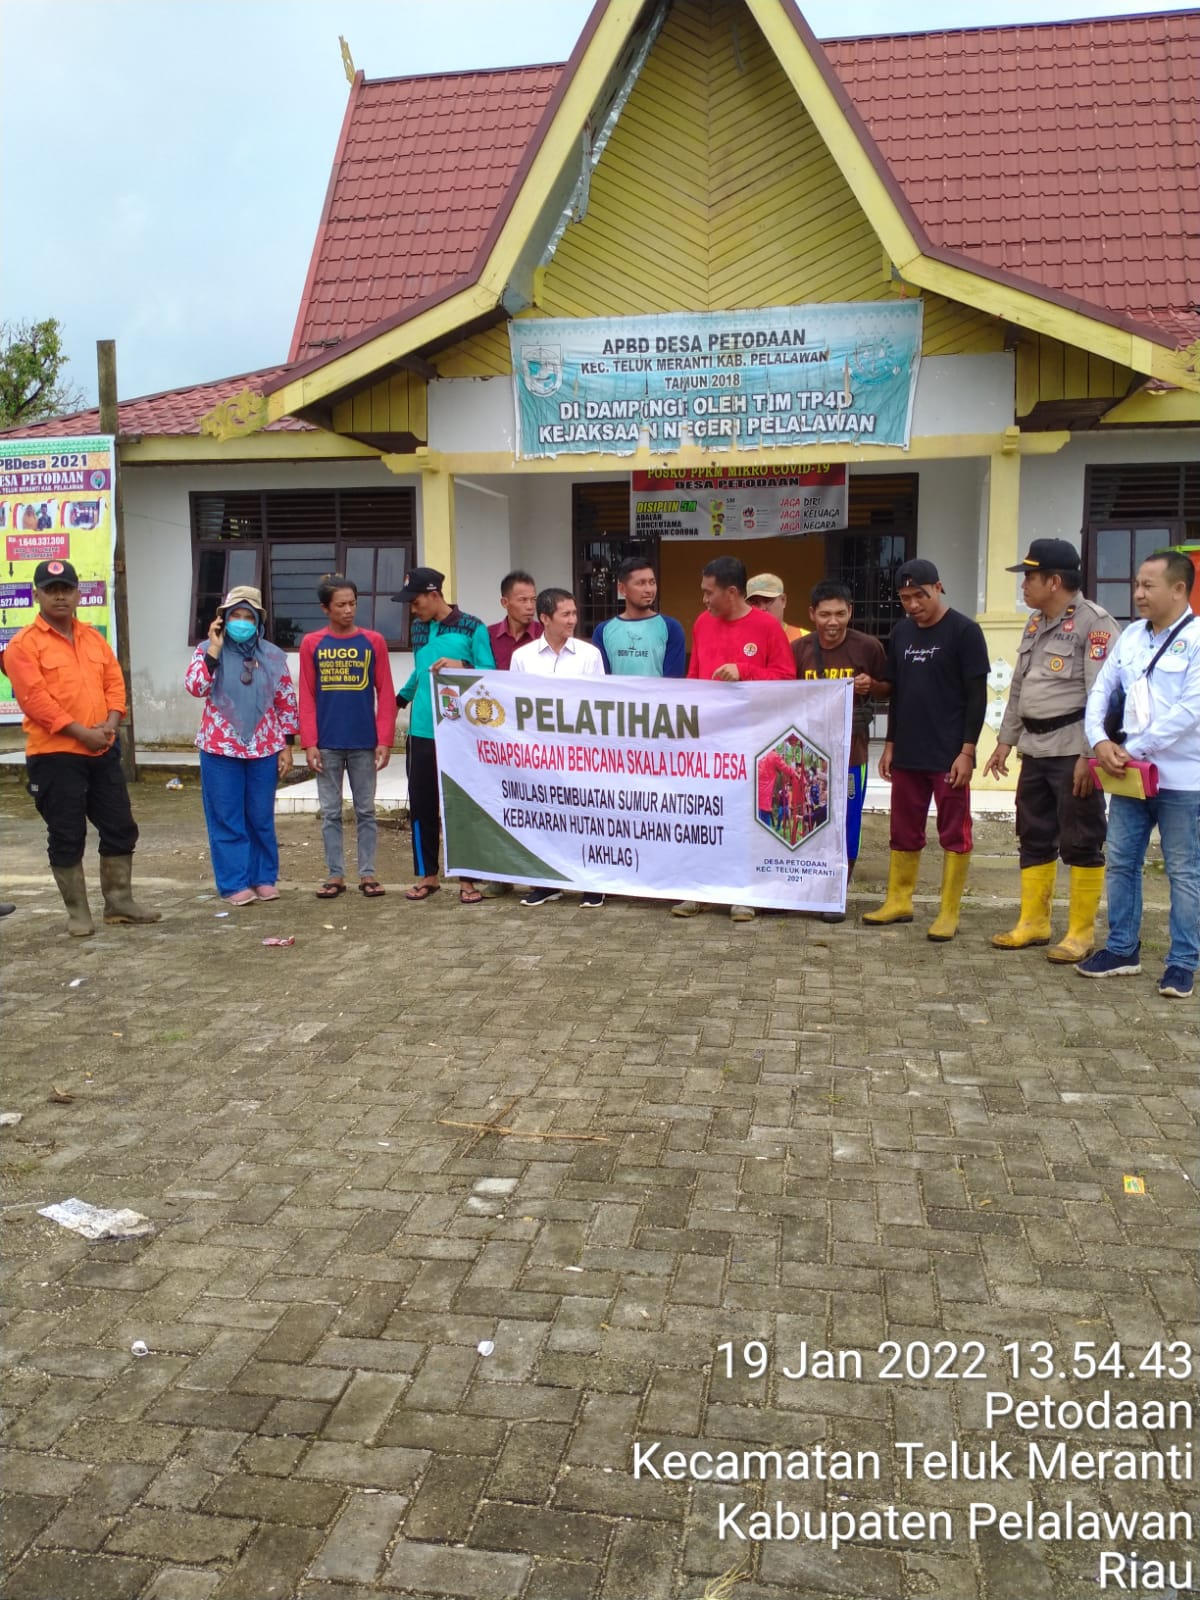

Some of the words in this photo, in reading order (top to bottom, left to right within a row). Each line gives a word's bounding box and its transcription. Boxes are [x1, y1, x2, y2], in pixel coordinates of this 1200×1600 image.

[602, 336, 650, 355] APBD
[655, 334, 703, 353] DESA
[708, 328, 806, 351] PETODAAN
[581, 360, 610, 374] KEC.
[613, 358, 652, 373] TELUK
[656, 355, 713, 371] MERANTI
[717, 352, 747, 367] KAB.
[750, 348, 828, 366] PELALAWAN
[711, 373, 741, 388] 2018
[560, 402, 580, 420] DI
[693, 394, 747, 415] OLEH
[752, 392, 793, 412] TIM
[797, 390, 854, 410] TP4D
[747, 413, 876, 436] PELALAWAN
[51, 454, 88, 468] 2021
[22, 471, 84, 486] PETODAAN
[648, 467, 687, 479] POSKO
[691, 466, 723, 478] PPKM
[728, 465, 768, 477] MIKRO
[772, 463, 831, 475] COVID-19
[675, 480, 714, 489] DESA
[718, 478, 799, 489] PETODAAN
[636, 501, 680, 513] DISIPLIN
[680, 500, 698, 512] 5M
[318, 648, 359, 660] HUGO
[515, 696, 701, 739] PELATIHAN
[476, 738, 565, 771] KESIAPSIAGAAN
[567, 744, 625, 774] BENCANA
[626, 748, 670, 777] SKALA
[670, 751, 711, 779] LOKAL
[713, 752, 748, 781] DESA
[501, 779, 548, 804] SIMULASI
[550, 784, 616, 810] PEMBUATAN
[617, 789, 658, 812] SUMUR
[660, 792, 724, 817] ANTISIPASI
[502, 807, 567, 833] KEBAKARAN
[569, 815, 605, 837] HUTAN
[607, 818, 631, 839] DAN
[633, 821, 671, 843] LAHAN
[674, 823, 725, 846] GAMBUT
[763, 858, 785, 866] DESA
[785, 859, 828, 868] PETODAAN
[775, 866, 800, 874] TELUK
[801, 868, 836, 877] MERANTI
[787, 875, 803, 883] 2021
